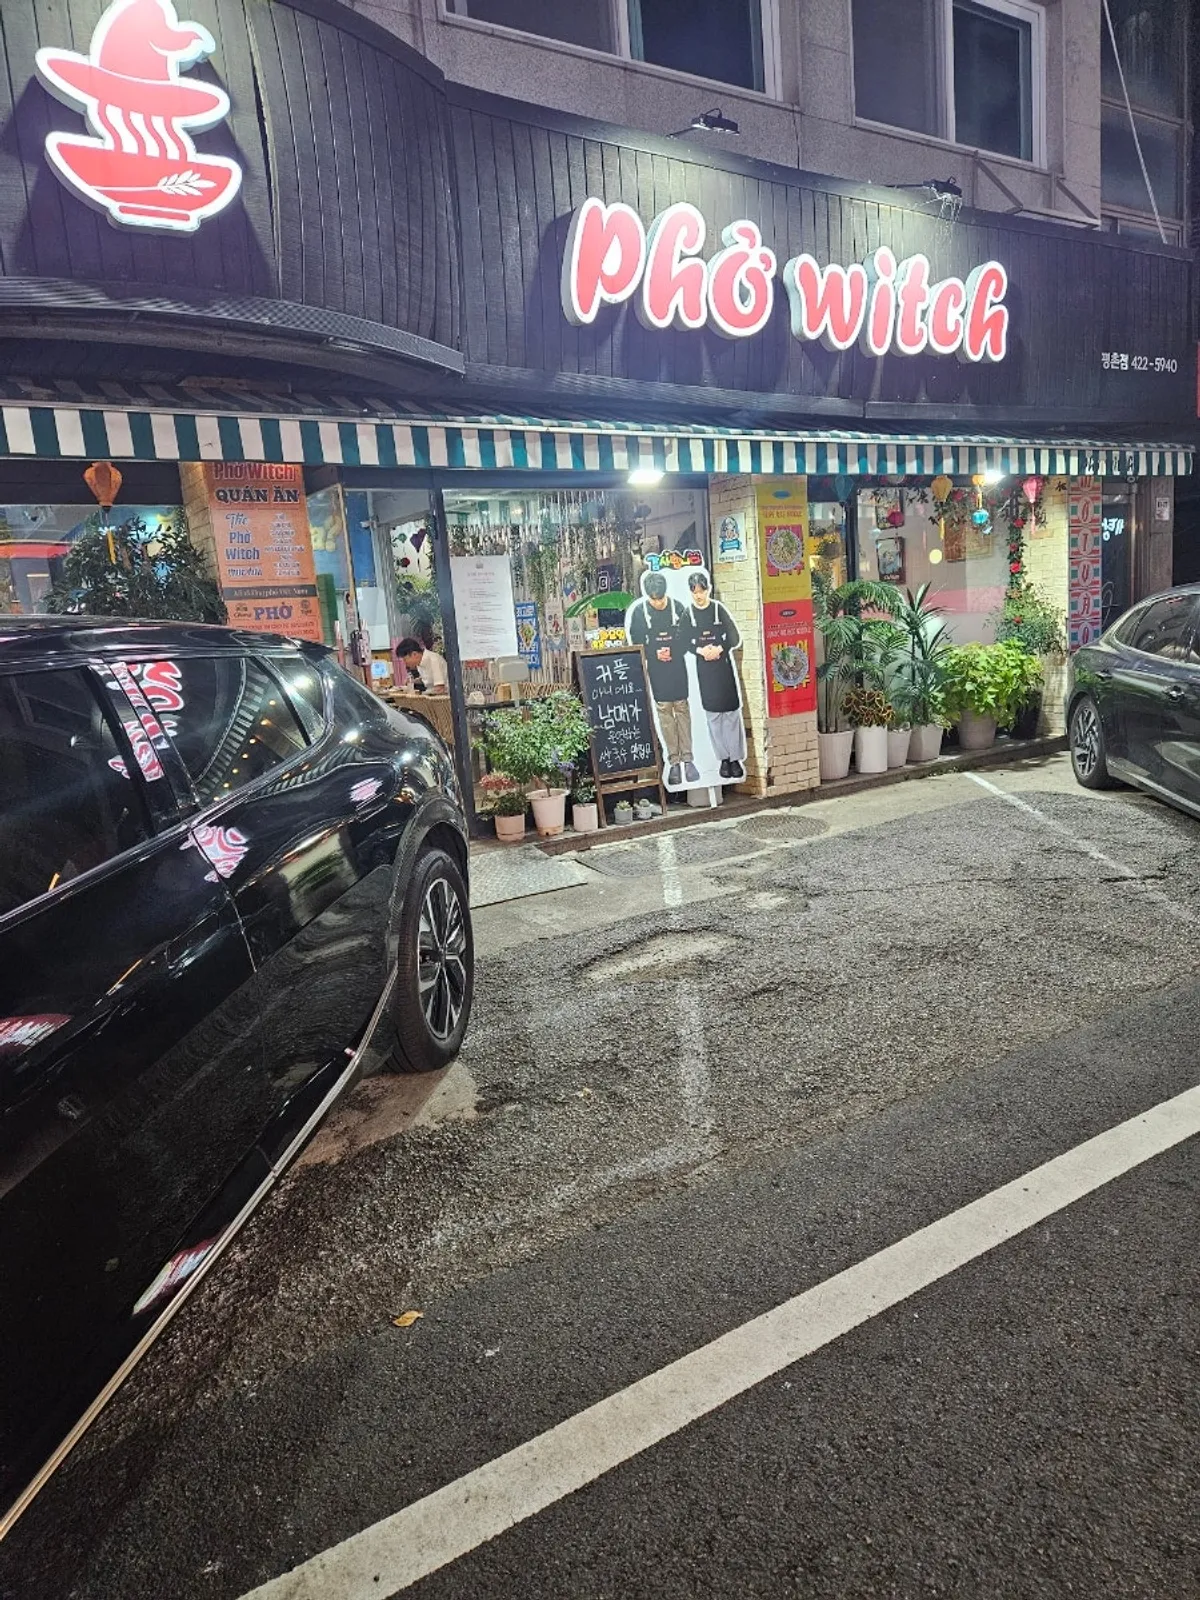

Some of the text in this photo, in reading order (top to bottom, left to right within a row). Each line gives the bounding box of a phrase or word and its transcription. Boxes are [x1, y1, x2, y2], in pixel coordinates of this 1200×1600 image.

[1101, 352, 1178, 373] 평촌점 422-5940
[215, 486, 268, 503] QUÁN
[225, 512, 248, 529] The
[225, 546, 260, 560] Witch
[598, 698, 642, 730] 남매가
